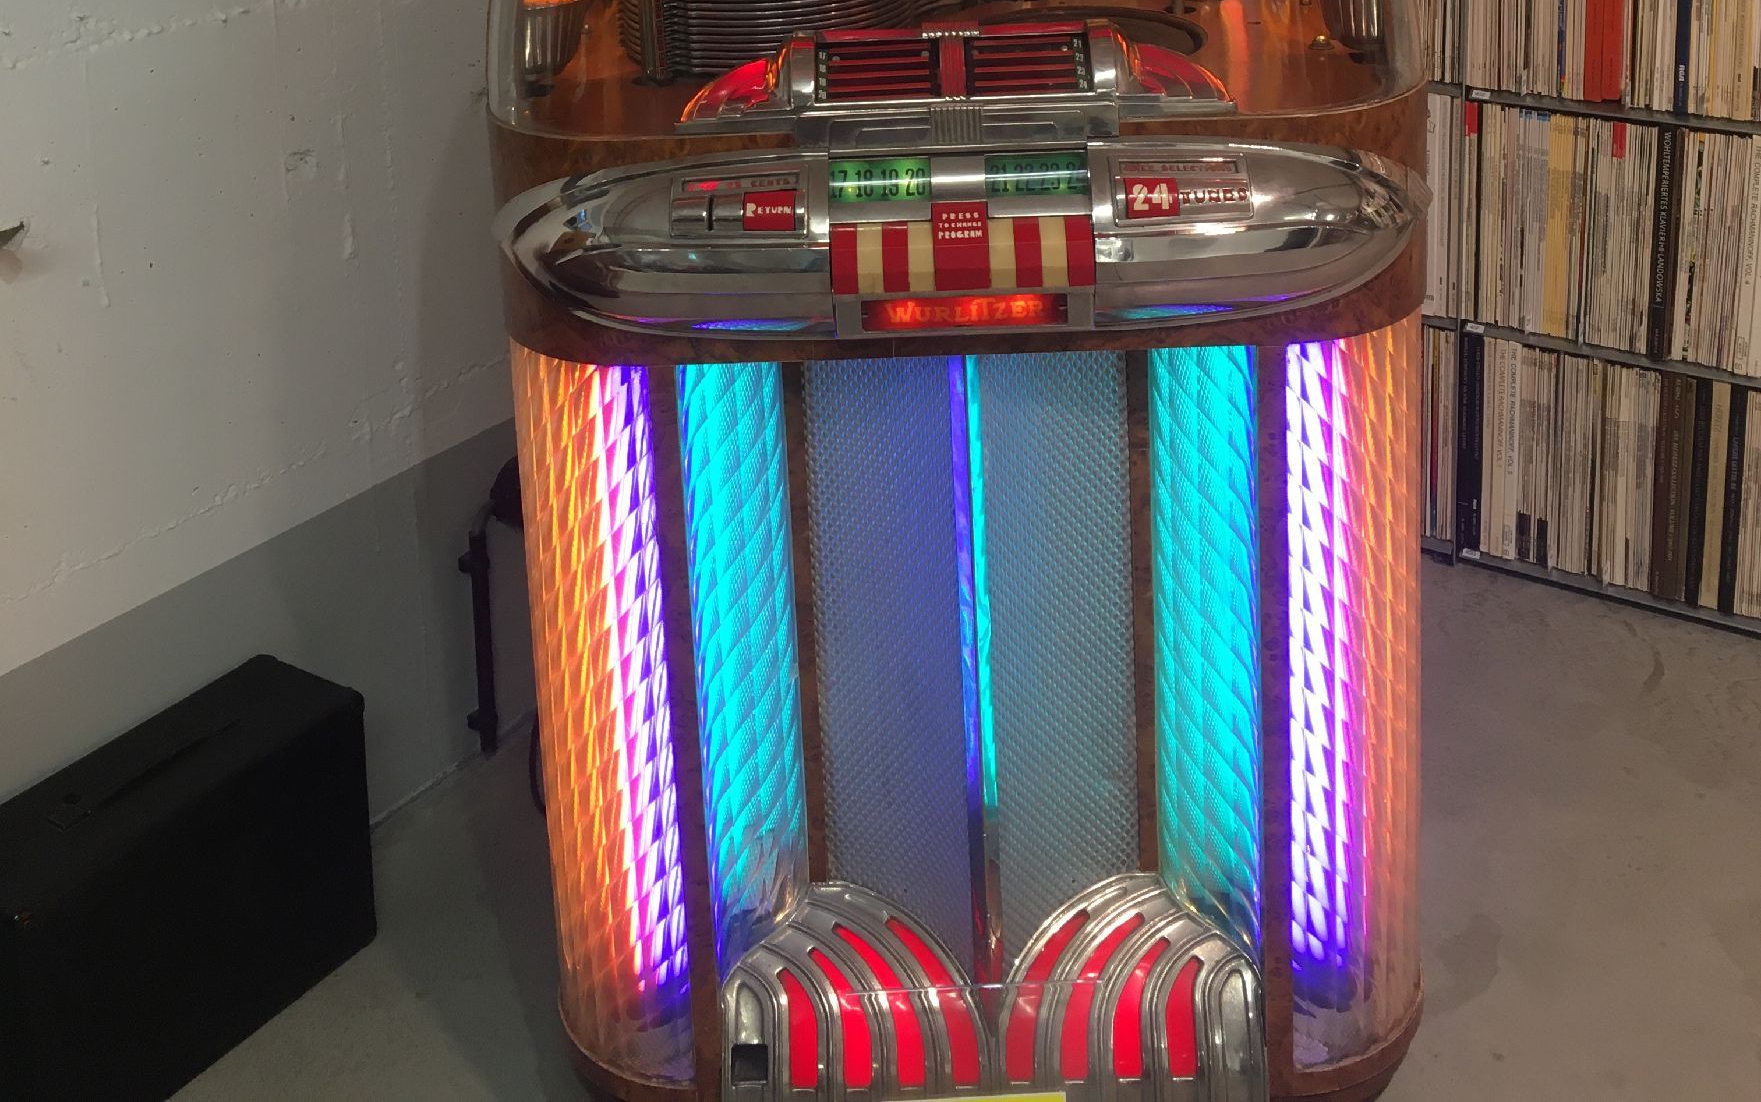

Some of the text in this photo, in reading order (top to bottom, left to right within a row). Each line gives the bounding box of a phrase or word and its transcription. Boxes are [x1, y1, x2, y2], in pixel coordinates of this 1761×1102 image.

[830, 167, 926, 199] 17 18 19 20
[989, 163, 1009, 193] 21
[1014, 162, 1035, 192] 22
[1039, 162, 1060, 190] 23
[1751, 162, 1761, 201] COMPLETE
[746, 202, 793, 217] RETURN
[1132, 183, 1248, 211] 24 TUNES
[942, 212, 979, 220] PRESS
[1655, 131, 1672, 303] WOHLTEMPERIERTES KLAVIER LANDOWSKA
[938, 229, 983, 240] PROGRAM
[884, 295, 1047, 324] WURLITZER
[1498, 361, 1506, 395] COMPLETE
[1509, 363, 1517, 397] COMPLETE
